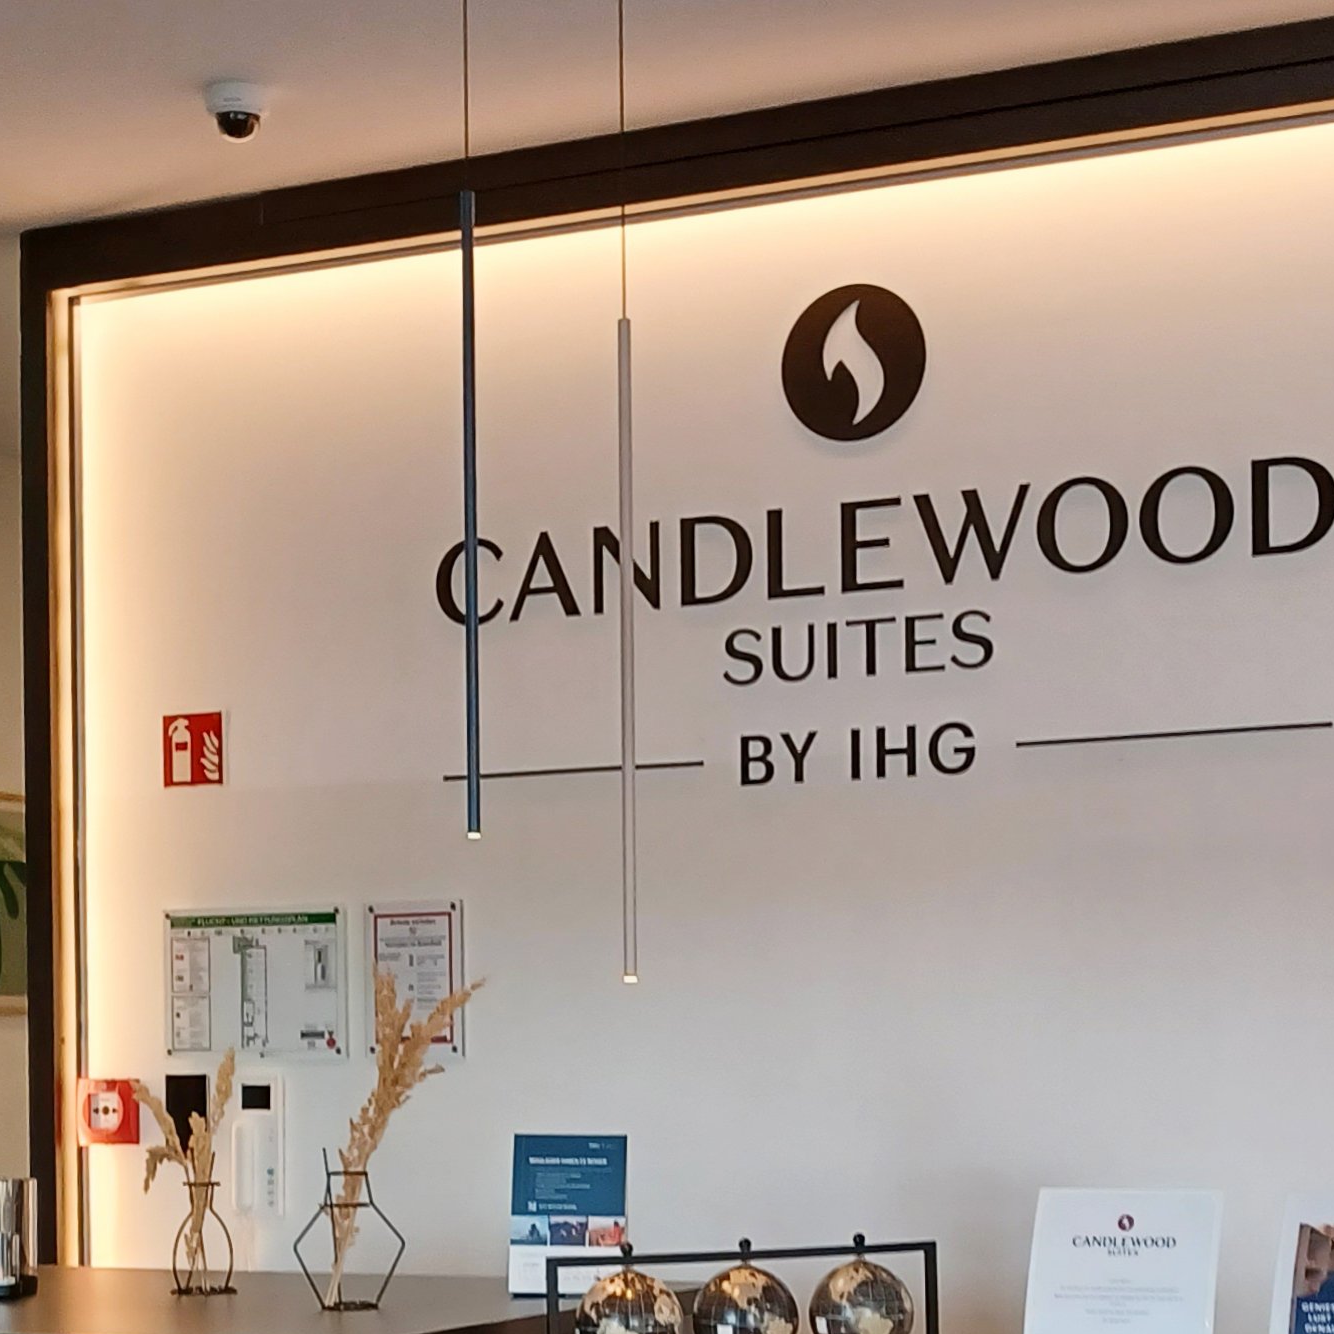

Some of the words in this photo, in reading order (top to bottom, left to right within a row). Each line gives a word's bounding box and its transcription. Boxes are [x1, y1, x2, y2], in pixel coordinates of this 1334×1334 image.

[723, 609, 994, 687] SUITES
[739, 731, 818, 787] BY
[849, 721, 977, 781] IHG
[1072, 1235, 1176, 1248] CANDLEWOOD
